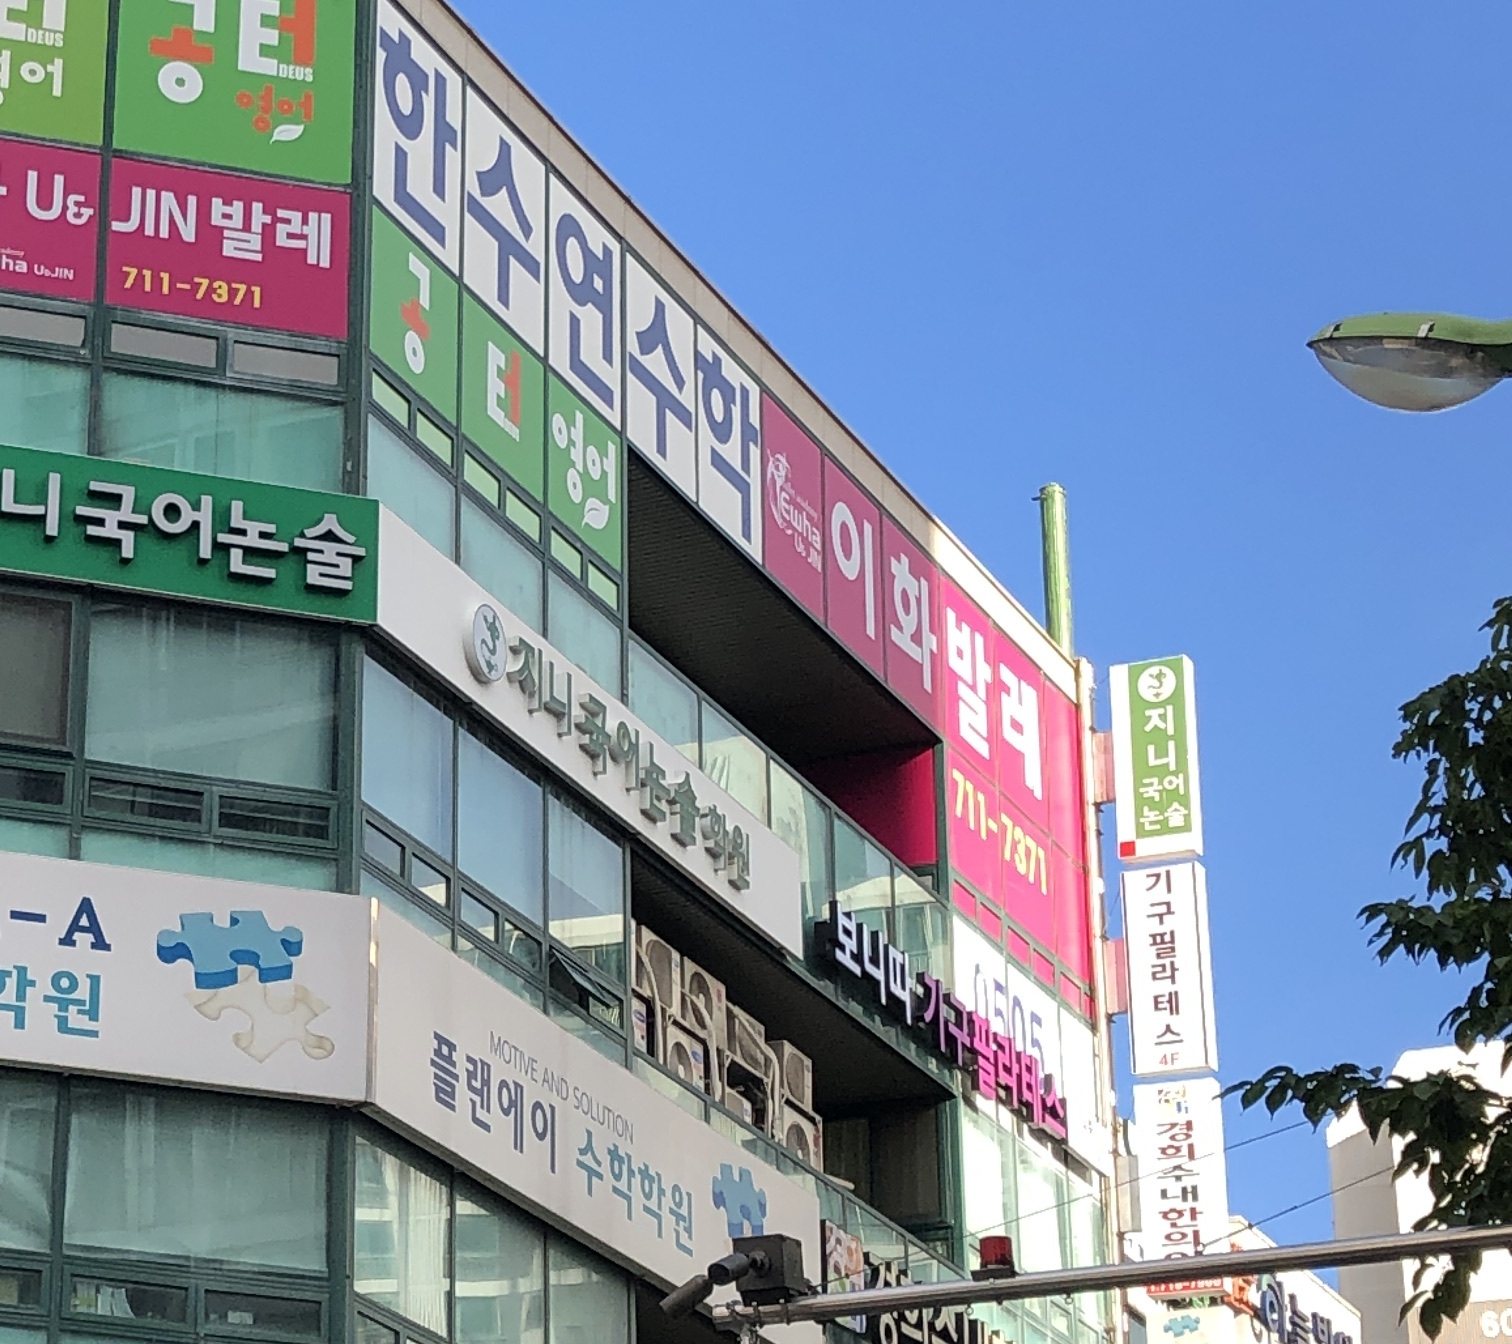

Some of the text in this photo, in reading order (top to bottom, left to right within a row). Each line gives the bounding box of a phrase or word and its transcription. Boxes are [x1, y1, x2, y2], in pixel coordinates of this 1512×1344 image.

[27, 27, 64, 47] DEUS
[278, 64, 314, 82] DEUS
[235, 84, 314, 134] 영어
[110, 185, 199, 243] JIN
[211, 196, 333, 269] 발레
[121, 266, 264, 308] 711-7371
[551, 410, 617, 505] 영어
[781, 491, 821, 550] Ewha
[831, 501, 1043, 801] 이화 발레
[1143, 705, 1177, 772] 지니
[952, 768, 1049, 895] 711-7371
[1144, 868, 1185, 1047] 기구필라테스
[488, 1029, 636, 1146] MOTIVE AND SOLUTION
[1158, 1053, 1180, 1067] 4F
[430, 1030, 696, 1259] 플랜에이 수학학원
[1155, 1119, 1206, 1260] 경희수내한의
